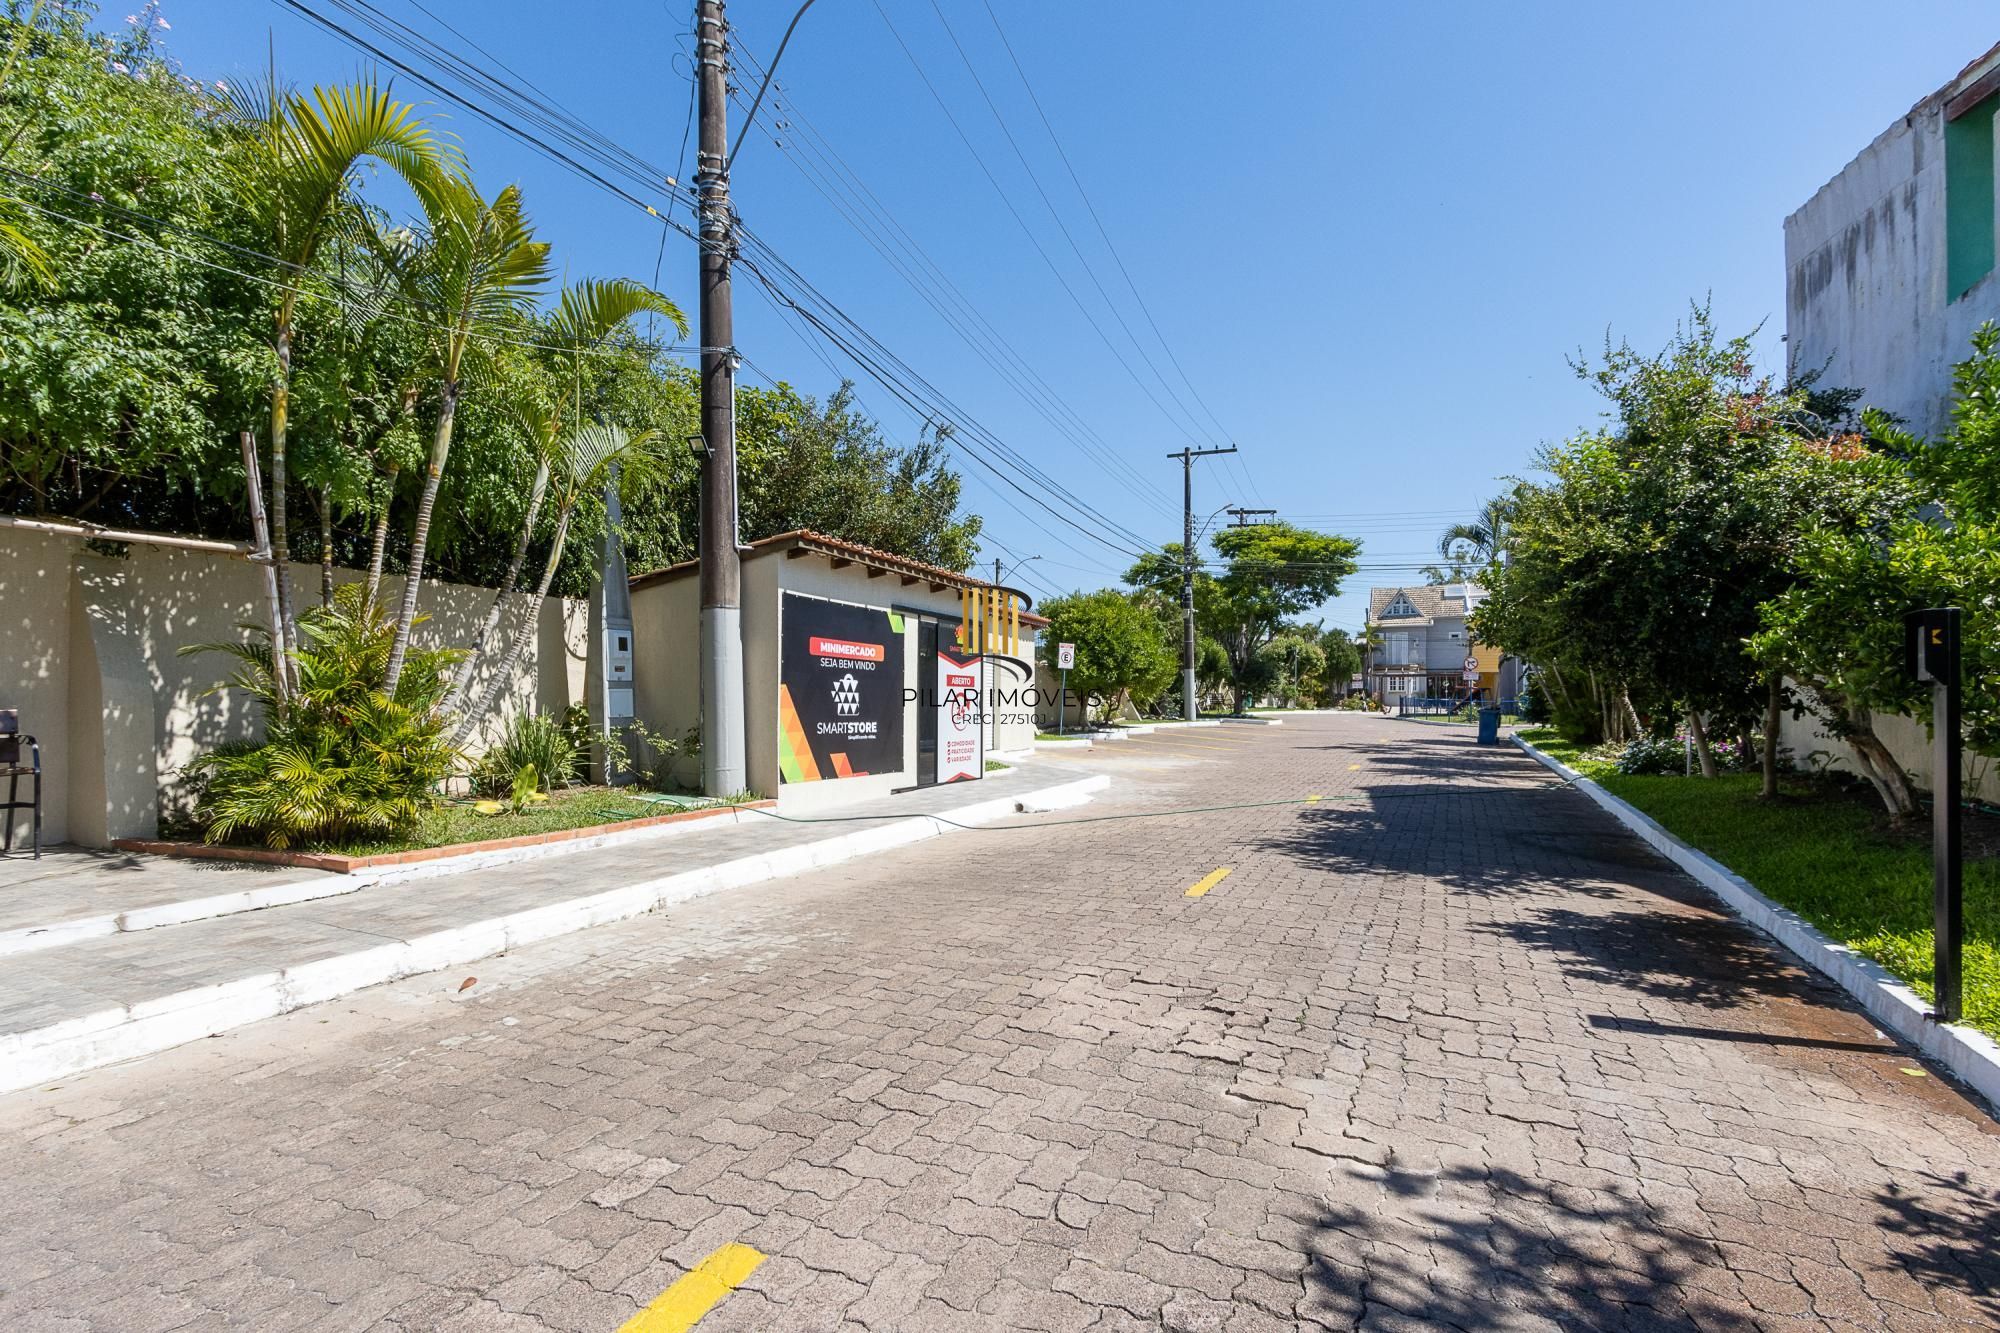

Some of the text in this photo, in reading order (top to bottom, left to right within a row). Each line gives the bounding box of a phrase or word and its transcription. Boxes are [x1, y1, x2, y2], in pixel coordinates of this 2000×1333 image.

[820, 642, 876, 657] MINIMERCADO
[1064, 654, 1069, 662] E
[820, 658, 876, 671] SEJA BEM VINDO
[952, 677, 971, 685] ABERTO
[816, 722, 878, 734] SMARTSTORE
